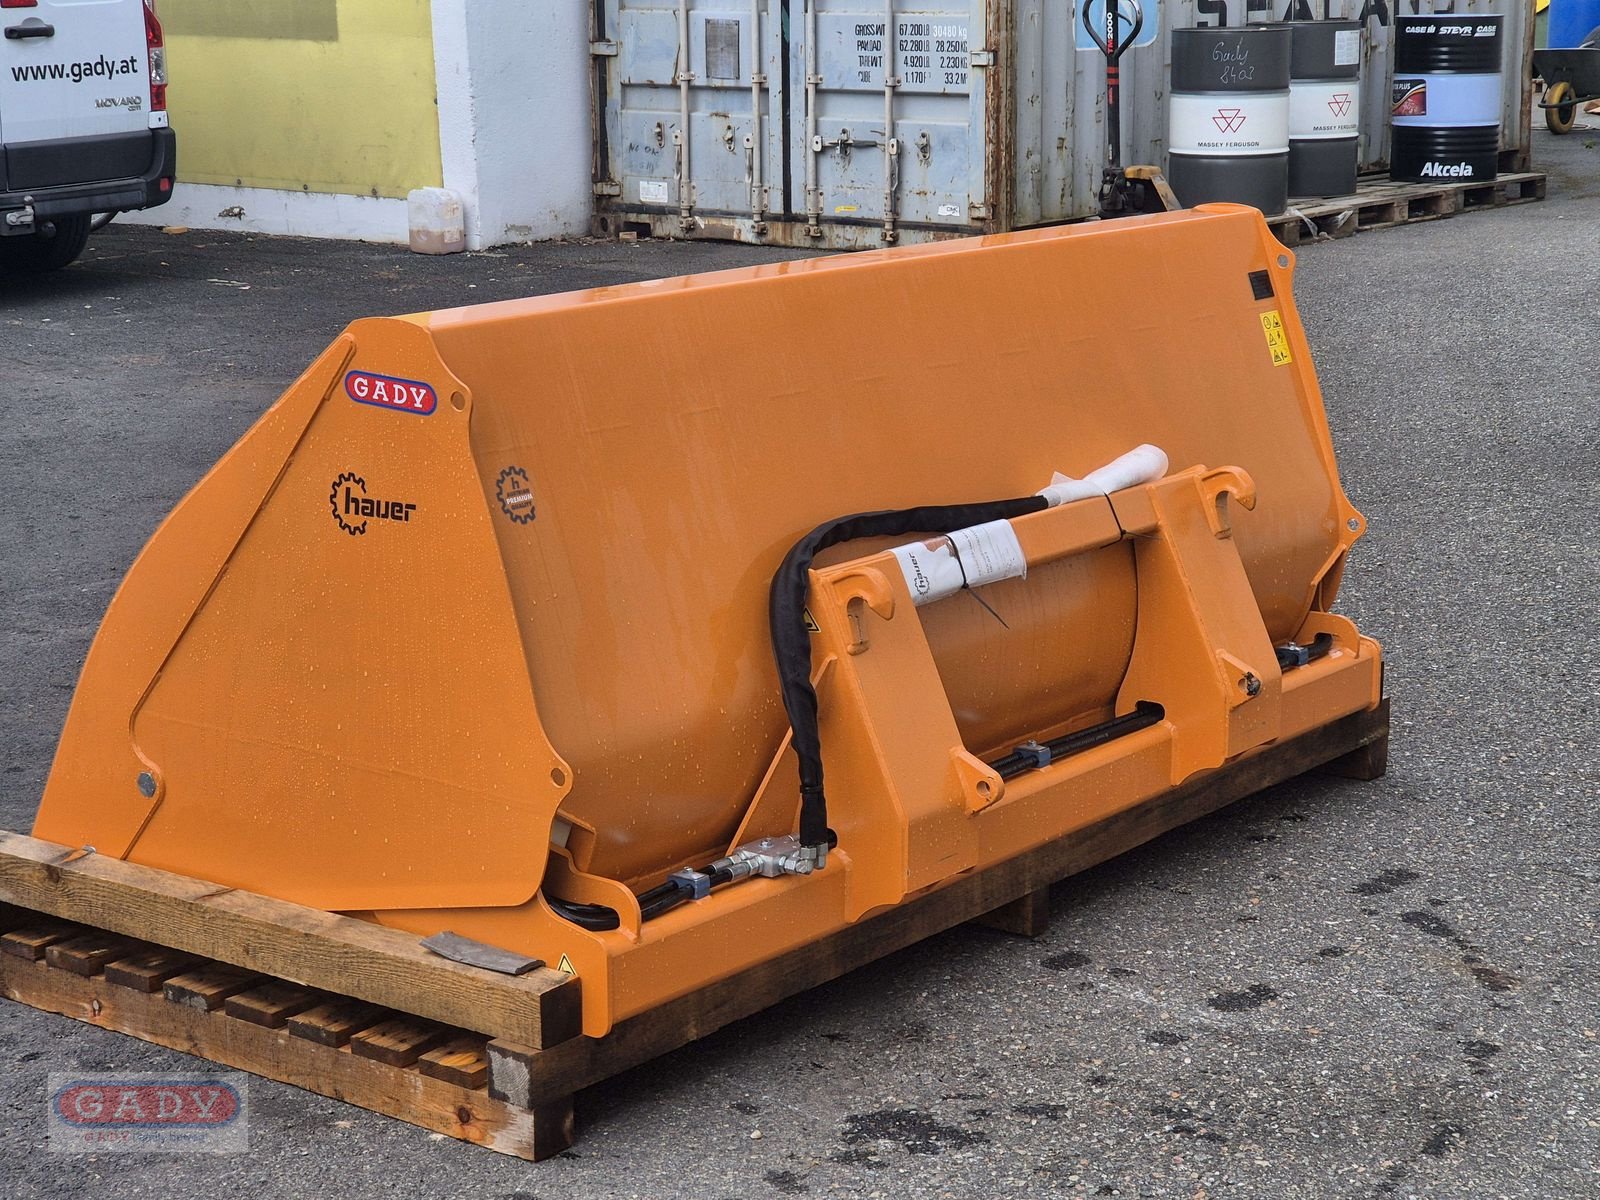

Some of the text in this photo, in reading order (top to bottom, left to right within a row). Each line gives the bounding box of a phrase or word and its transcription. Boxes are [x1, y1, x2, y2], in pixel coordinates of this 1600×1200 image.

[899, 24, 923, 36] 67.200
[933, 25, 957, 38] 30480
[958, 25, 968, 39] kg
[1405, 26, 1427, 34] CASE
[1439, 26, 1473, 35] STEYR
[1476, 25, 1497, 33] CASE
[899, 40, 923, 52] 62.280
[935, 41, 960, 53] 28.250
[11, 55, 138, 82] www.gady.at
[903, 55, 923, 68] 4.920
[940, 56, 960, 69] 2.230
[95, 96, 142, 109] MOVANO
[1420, 162, 1473, 177] Akcela
[353, 377, 427, 408] GADY
[344, 486, 417, 522] hauer
[506, 493, 533, 505] PREMIUM
[908, 552, 927, 589] hauer
